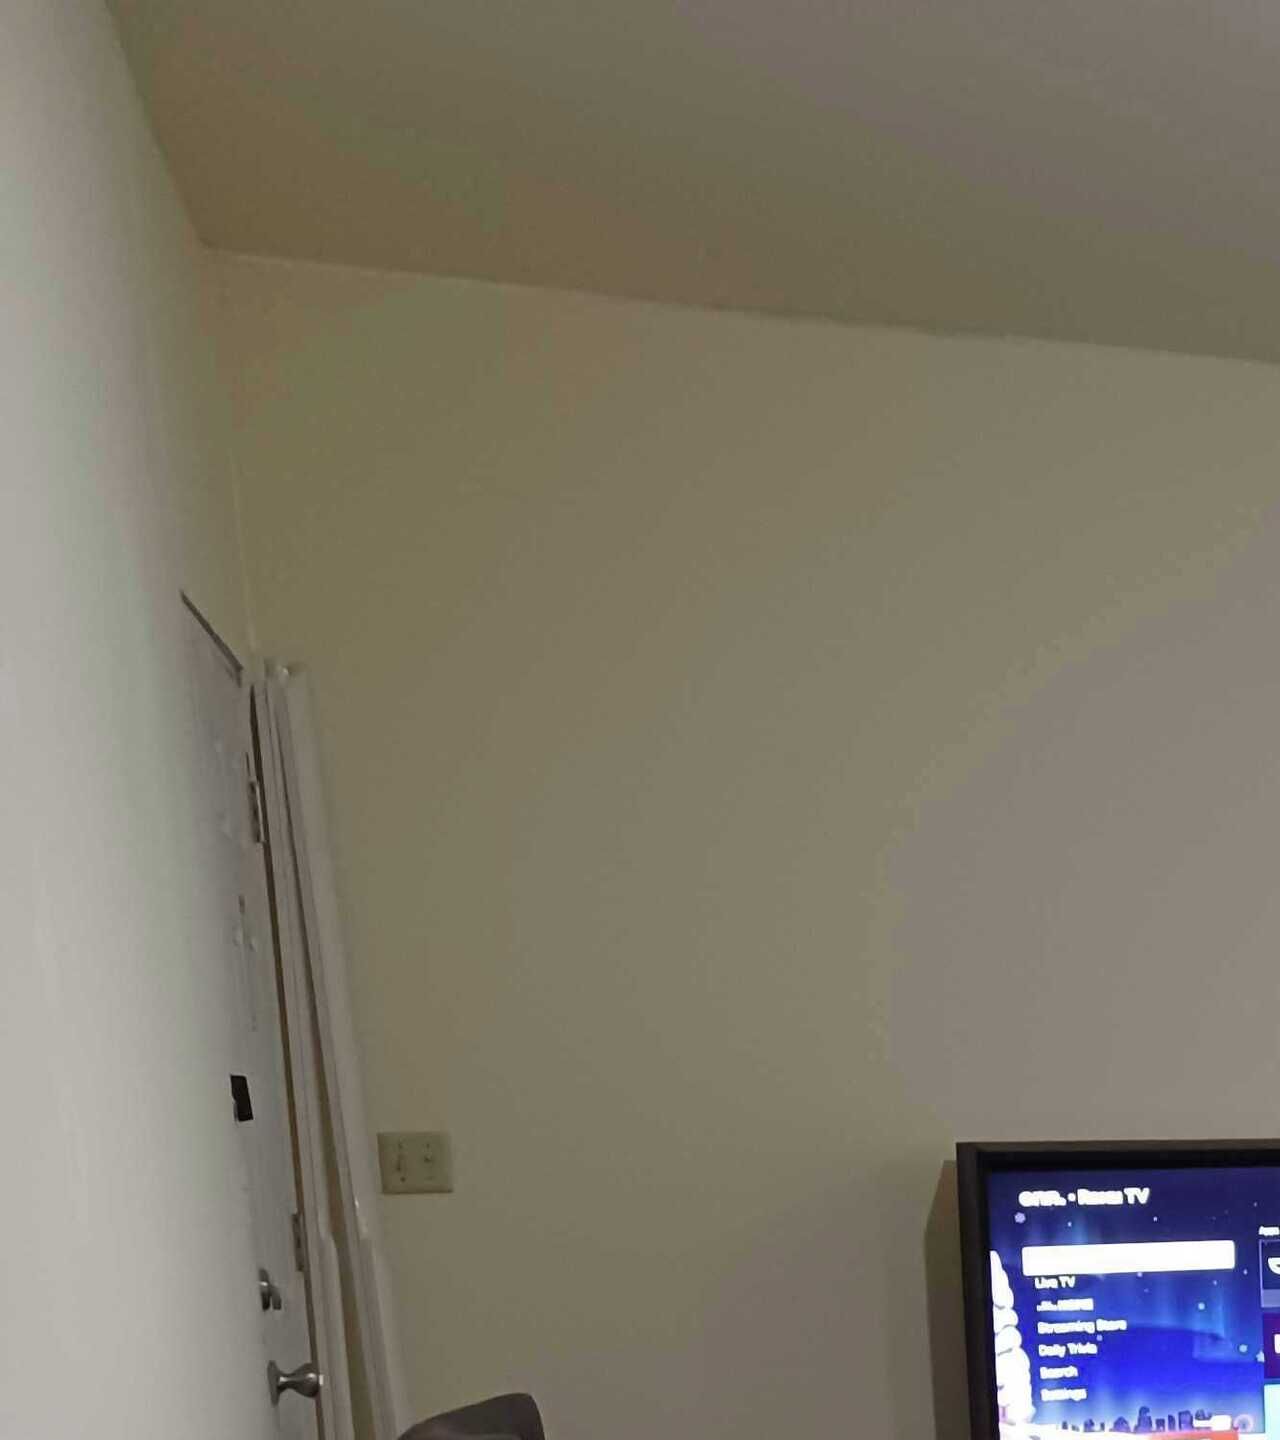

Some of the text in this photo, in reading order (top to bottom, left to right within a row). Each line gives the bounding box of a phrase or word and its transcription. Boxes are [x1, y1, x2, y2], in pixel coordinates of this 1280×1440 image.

[1124, 1187, 1150, 1204] TV
[1035, 1276, 1075, 1289] Live TV
